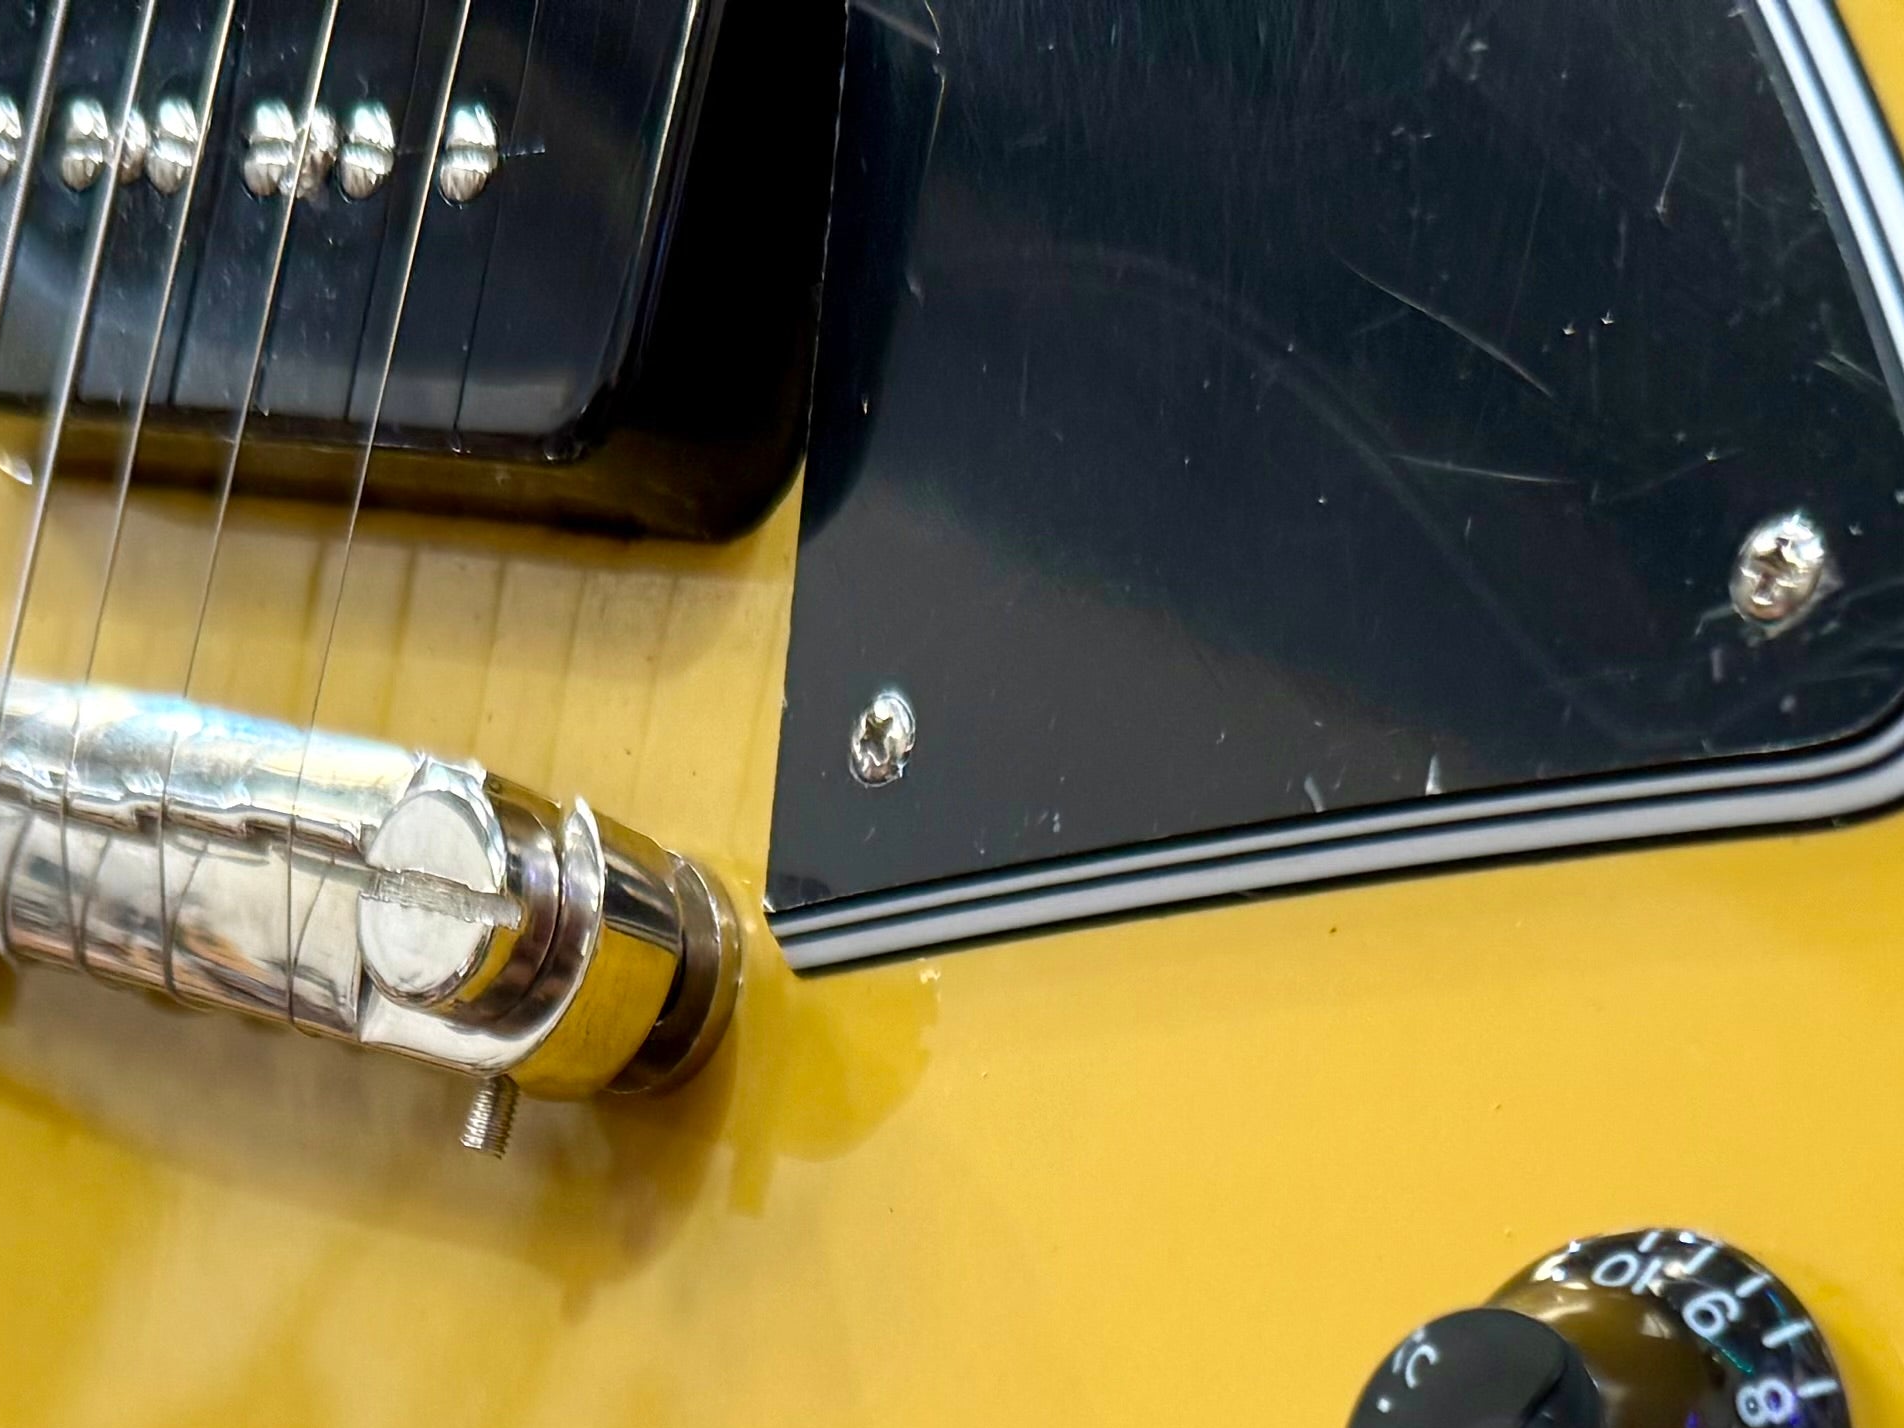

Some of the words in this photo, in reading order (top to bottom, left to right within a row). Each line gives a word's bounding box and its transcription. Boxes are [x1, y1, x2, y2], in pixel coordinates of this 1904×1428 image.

[1591, 1253, 1661, 1294] 10
[1682, 1290, 1739, 1340] 9
[1736, 1379, 1795, 1427] 8
